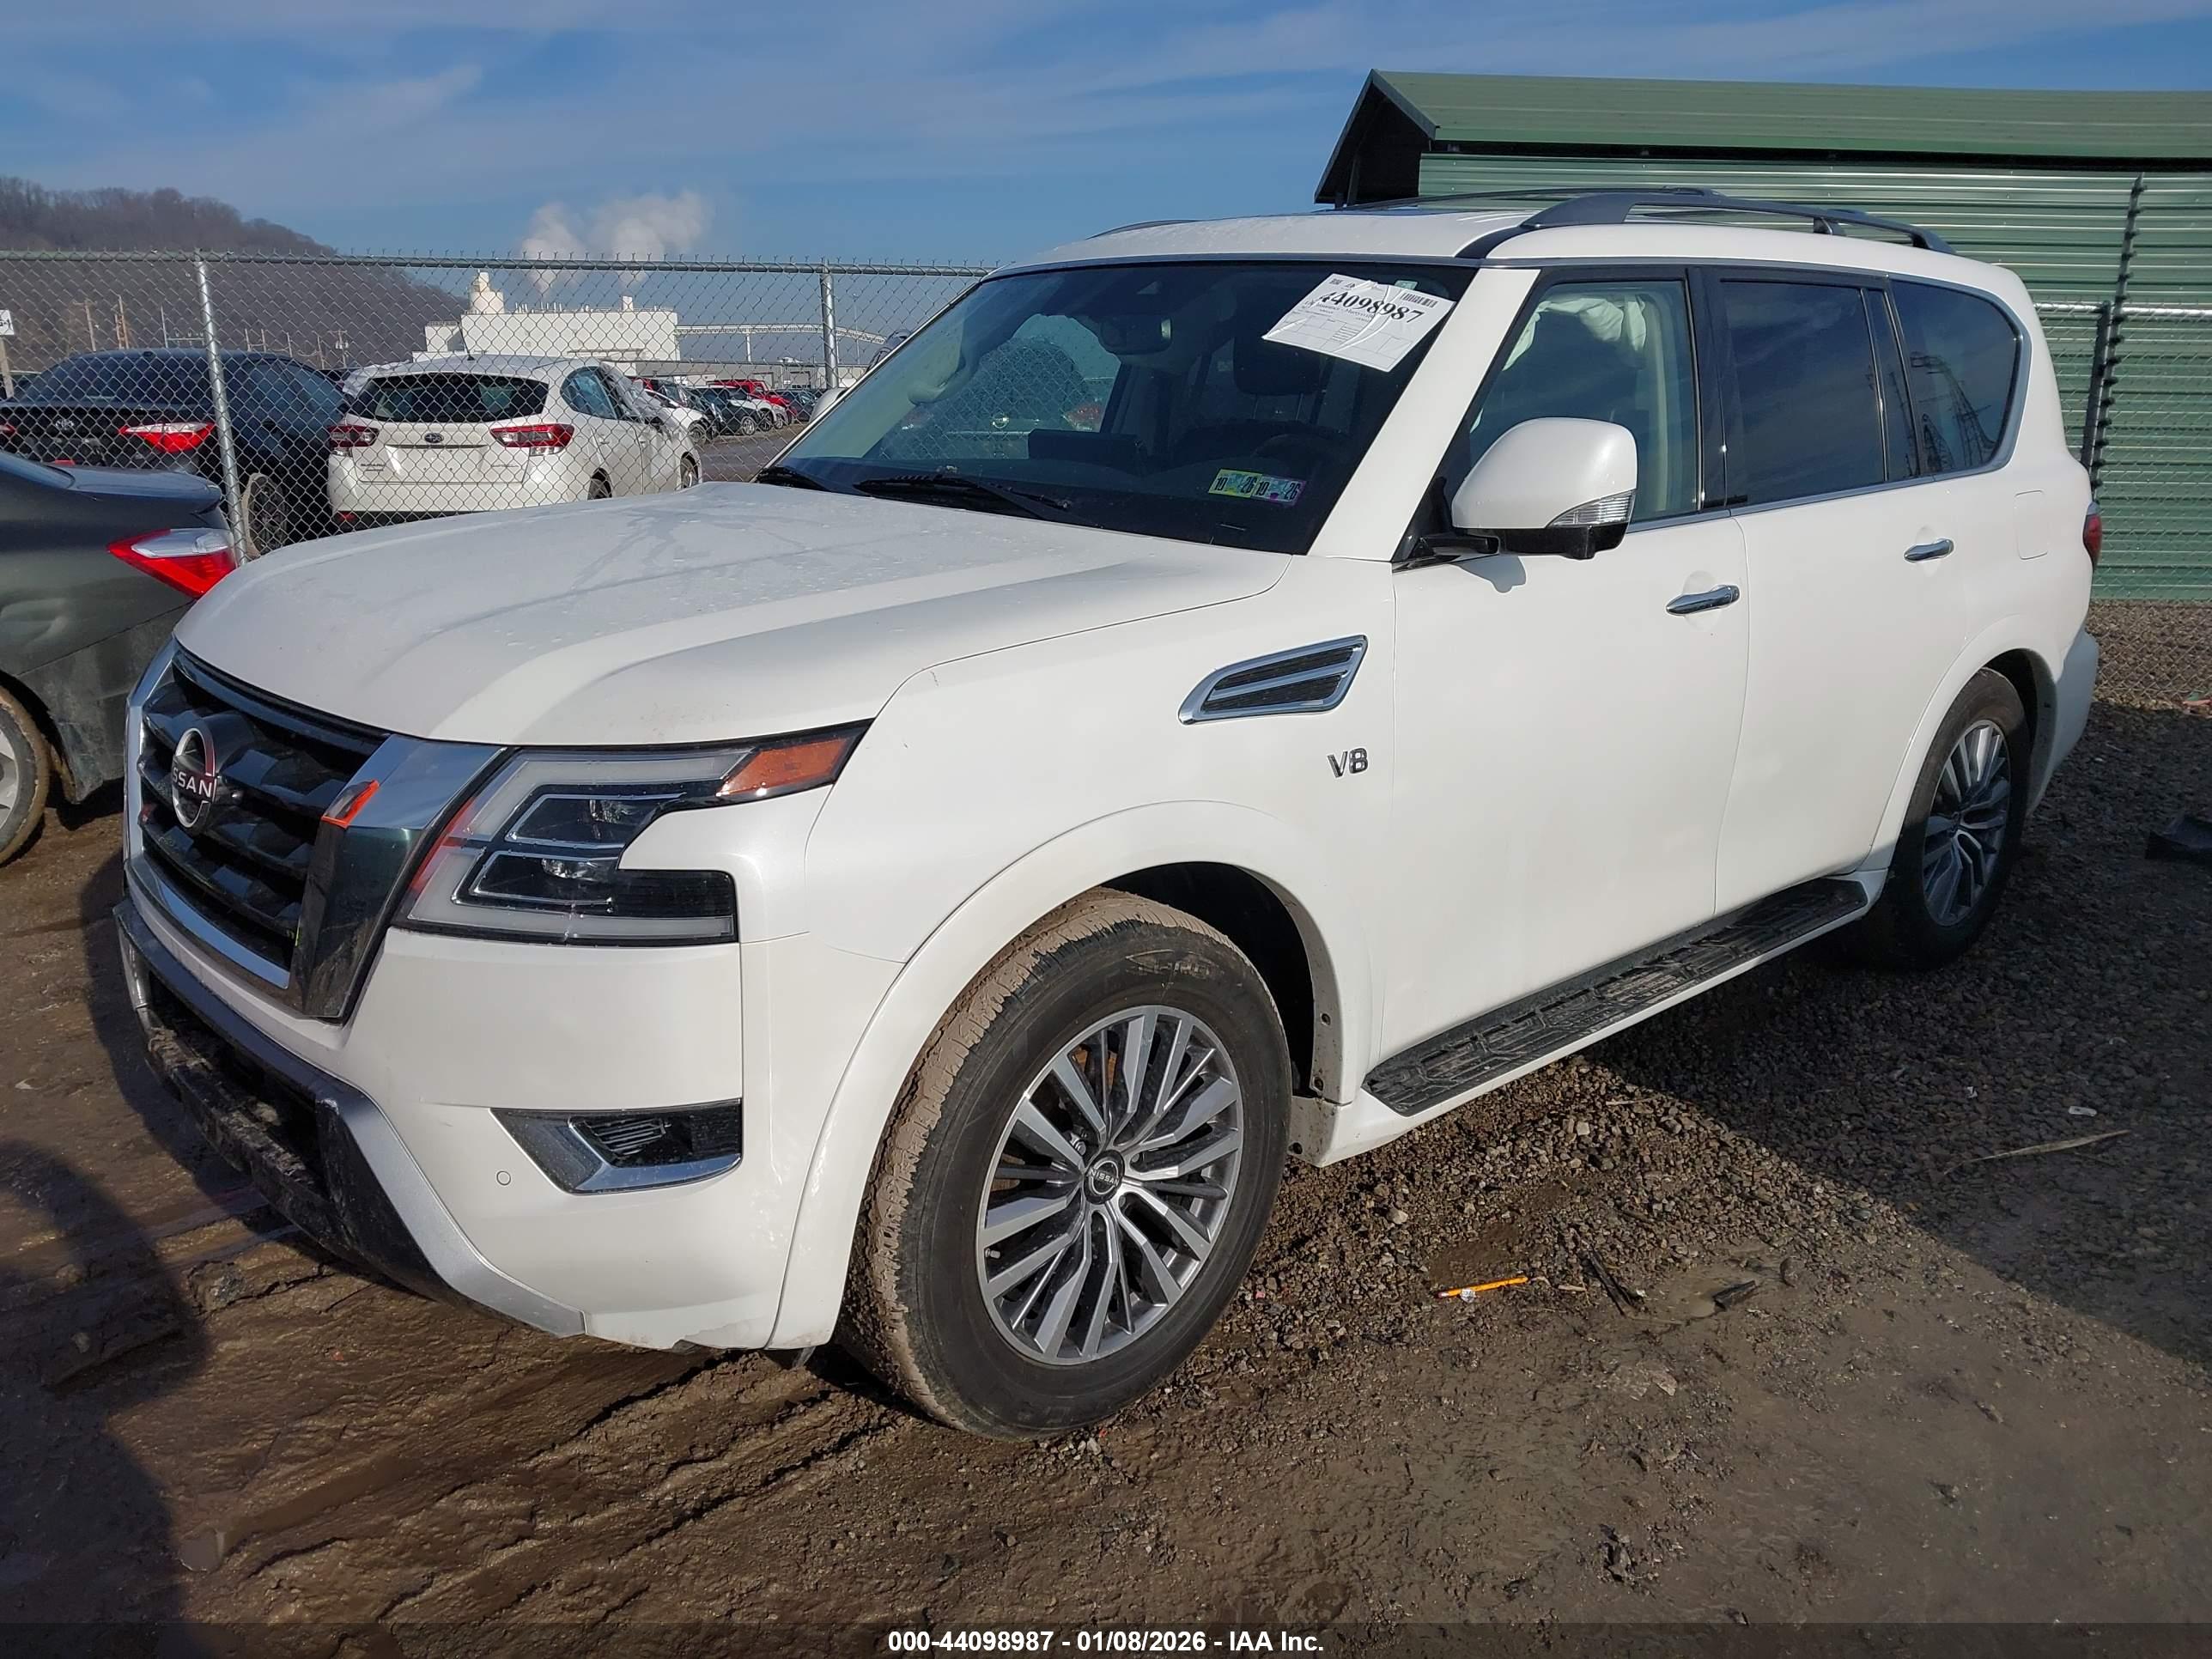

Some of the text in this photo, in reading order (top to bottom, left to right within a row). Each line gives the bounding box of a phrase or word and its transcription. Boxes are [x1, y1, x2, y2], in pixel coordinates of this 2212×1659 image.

[1319, 291, 1425, 323] 44098987
[1214, 477, 1257, 494] 10 26
[1256, 481, 1302, 500] 10 26
[1327, 748, 1368, 778] V8
[173, 764, 213, 798] SSAN
[1090, 1168, 1119, 1187] NISSAN
